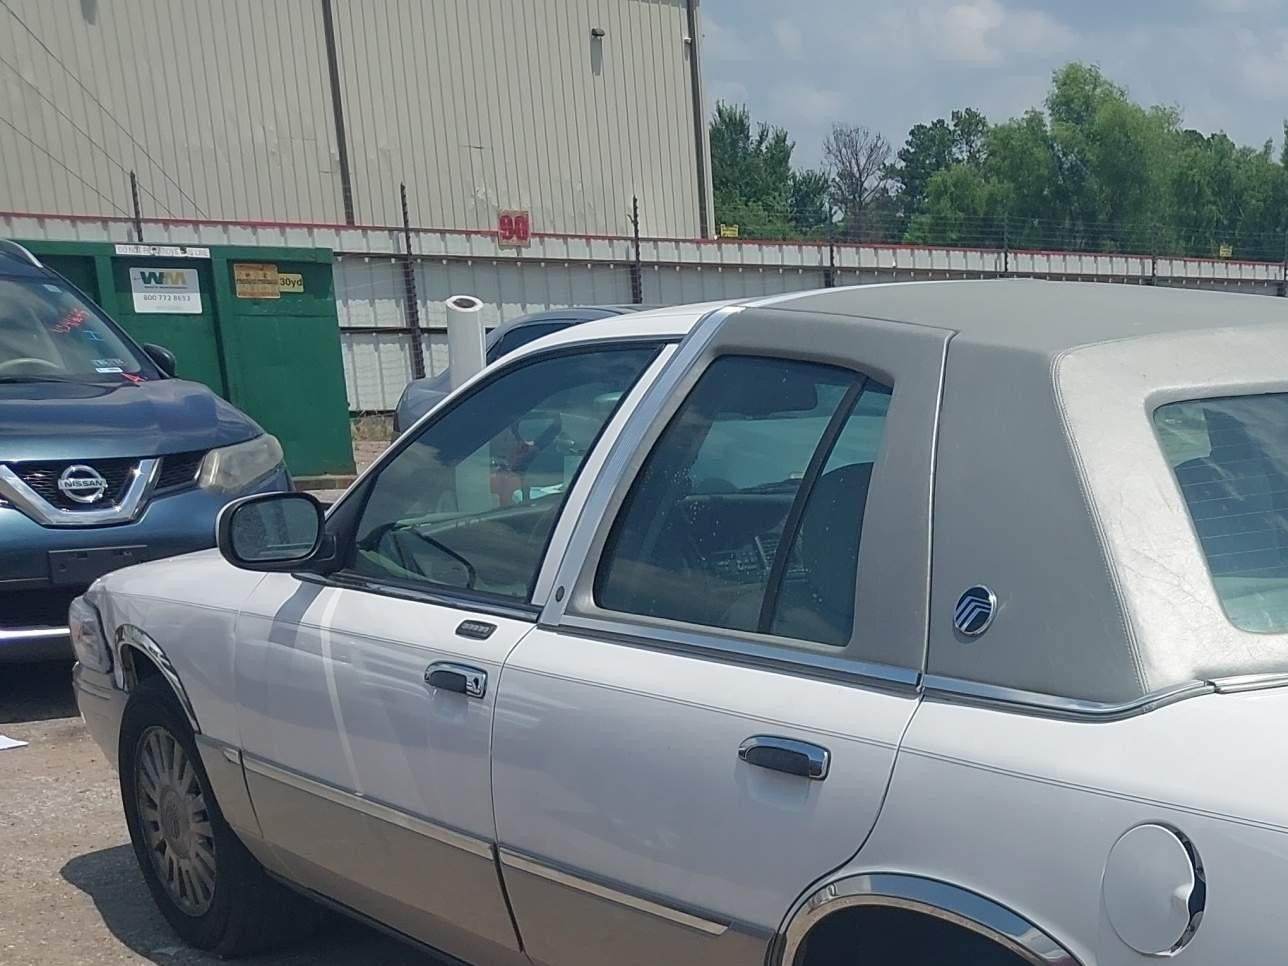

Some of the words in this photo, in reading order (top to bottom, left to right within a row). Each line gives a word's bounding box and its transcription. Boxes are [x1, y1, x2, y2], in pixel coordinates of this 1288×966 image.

[499, 214, 529, 240] 90
[140, 271, 187, 285] WM
[280, 277, 303, 288] 30yd
[64, 480, 104, 488] NISSAN
